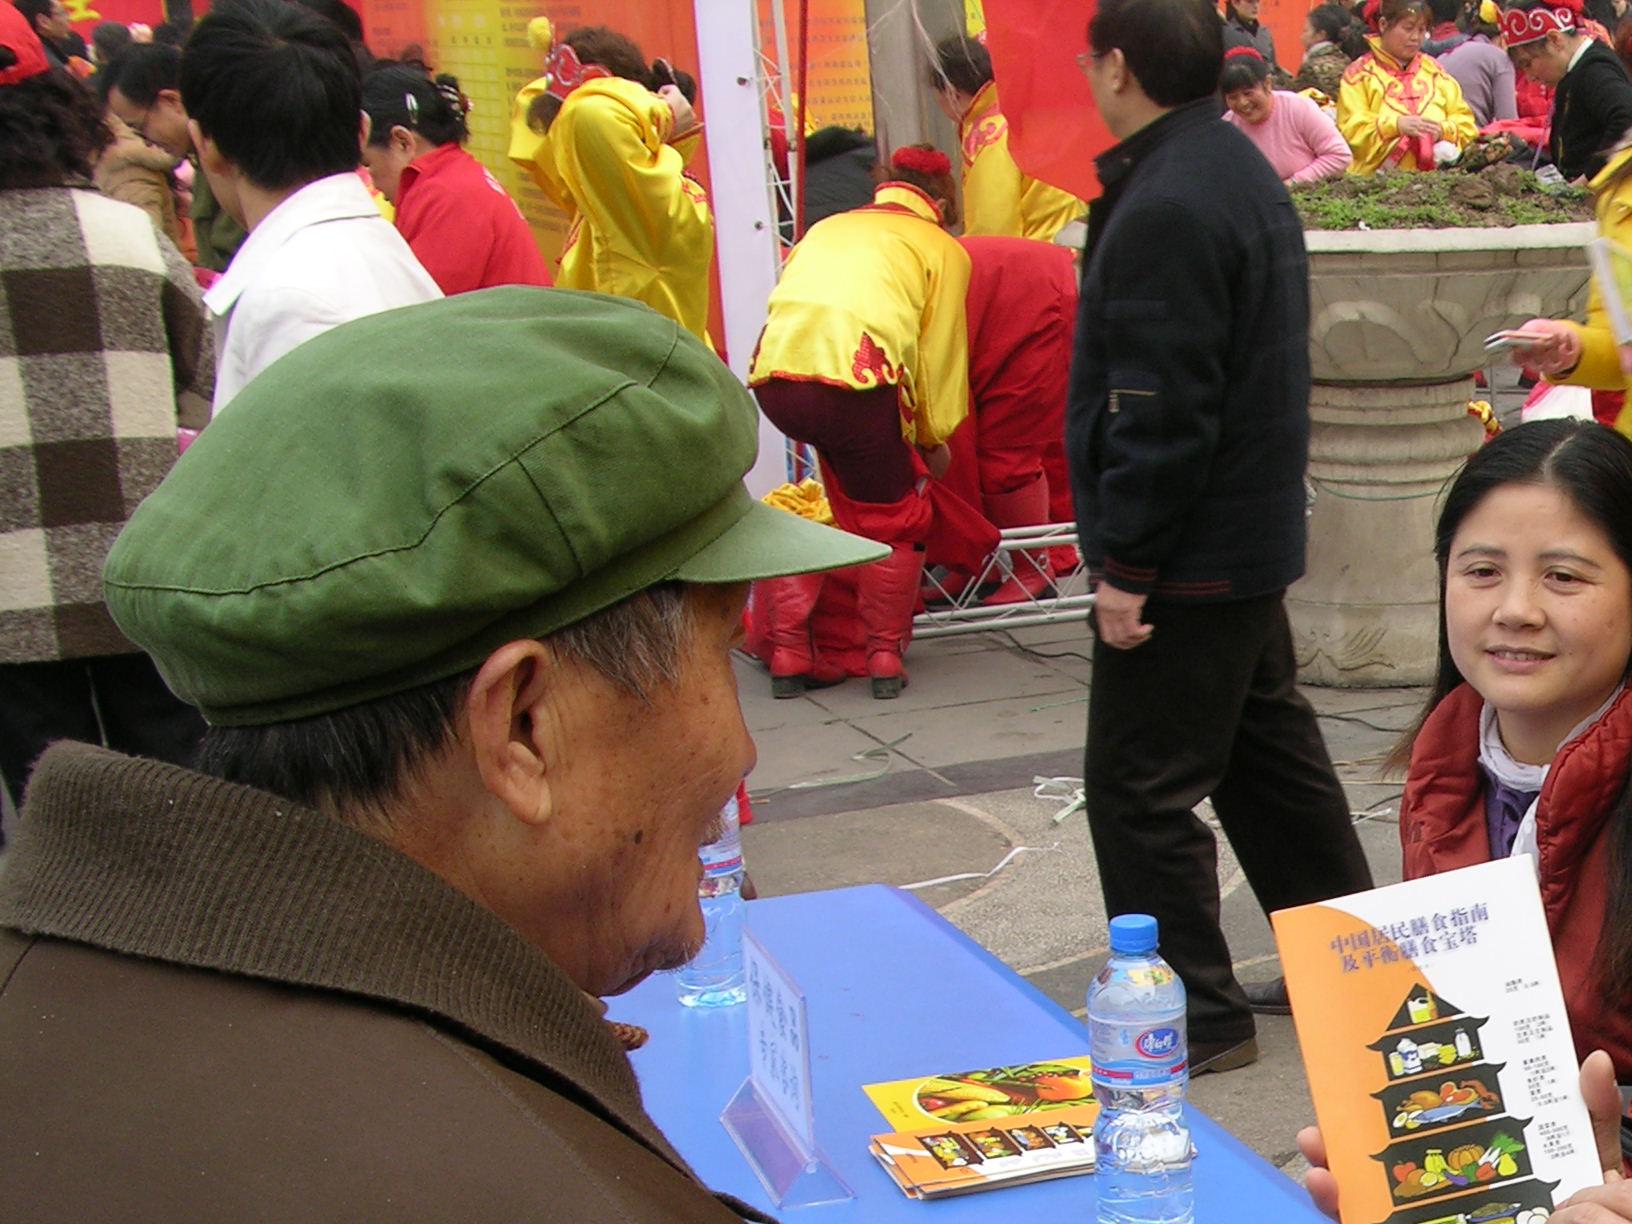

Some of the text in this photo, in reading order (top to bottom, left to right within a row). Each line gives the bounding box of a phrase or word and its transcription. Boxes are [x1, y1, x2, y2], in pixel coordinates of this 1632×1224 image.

[1331, 902, 1490, 954] 中国居民膳食指南
[1342, 926, 1478, 972] 及平衡膳食宝塔
